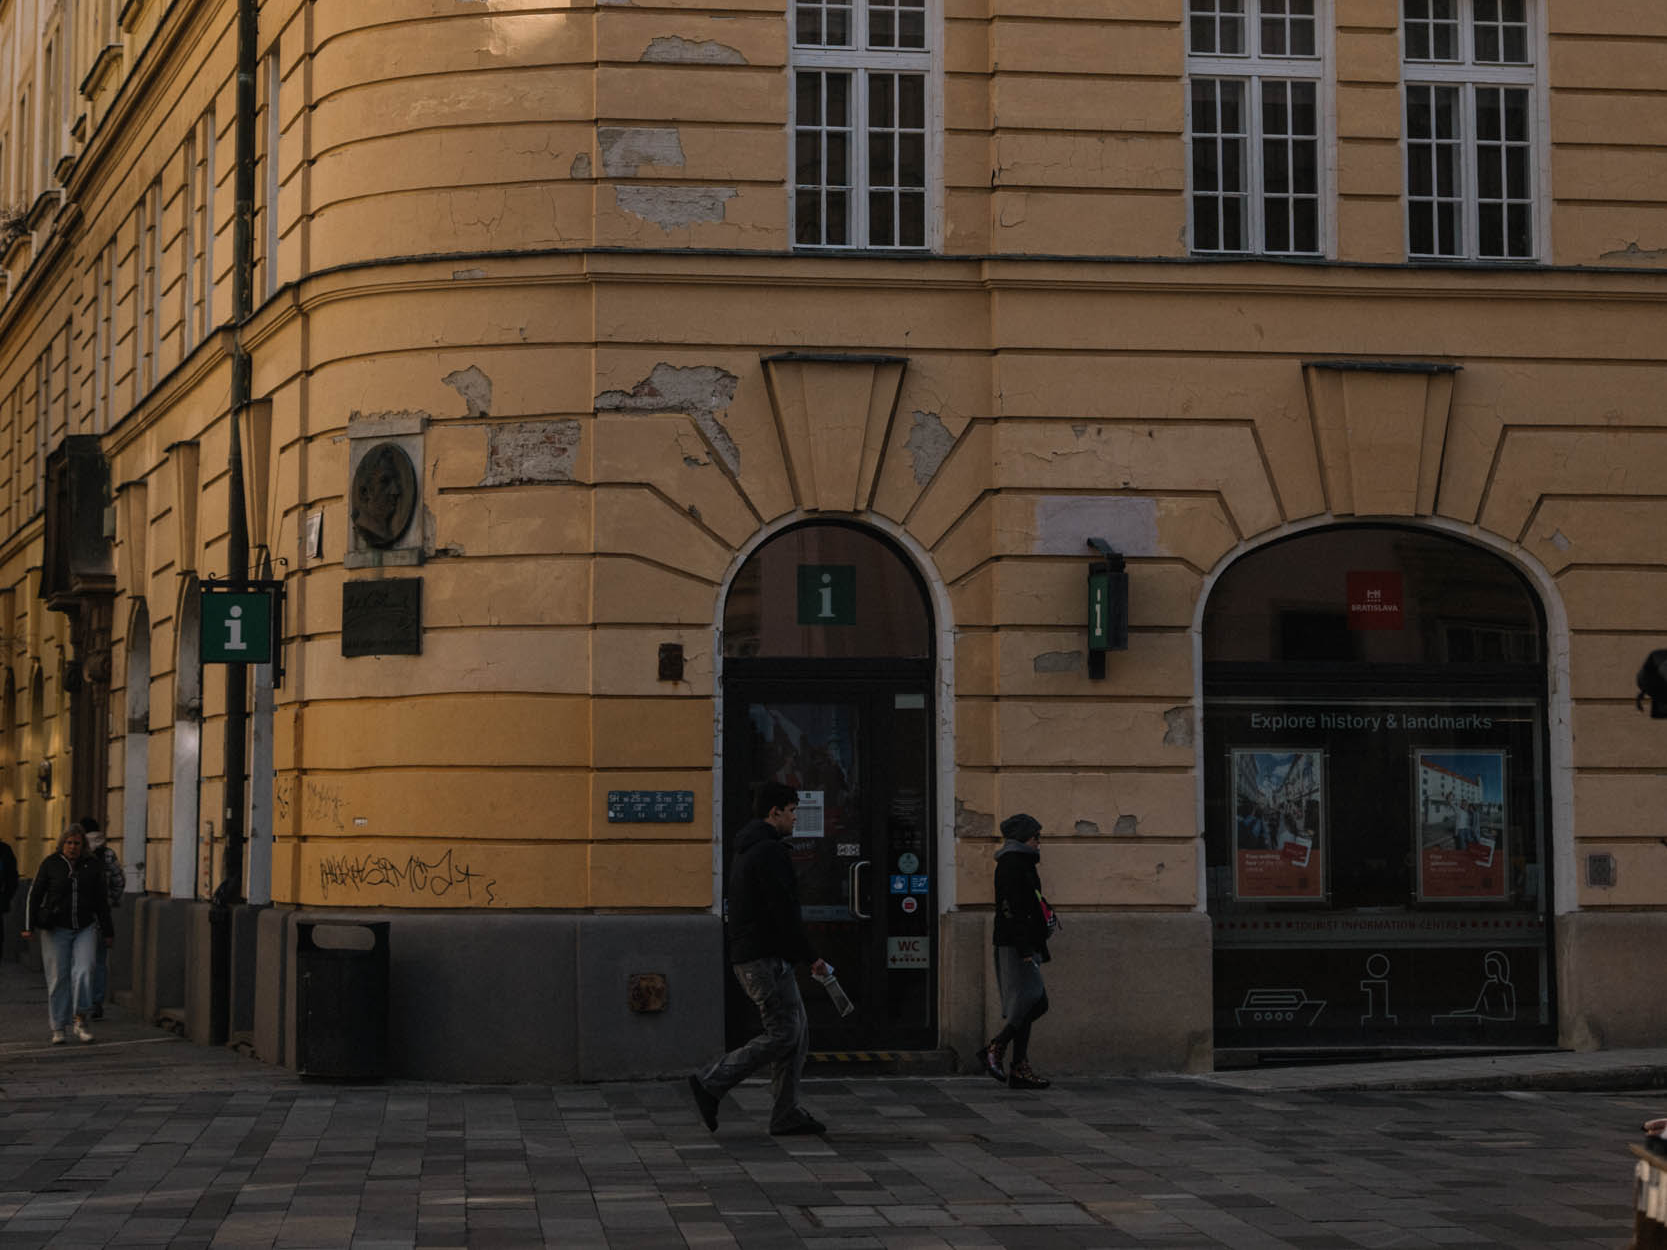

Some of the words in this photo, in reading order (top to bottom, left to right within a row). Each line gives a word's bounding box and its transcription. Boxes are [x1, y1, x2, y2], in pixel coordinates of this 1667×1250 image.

[1351, 604, 1399, 613] BRATISLAVA
[1250, 712, 1317, 732] Explore
[1320, 712, 1382, 732] history
[1385, 713, 1398, 729] &
[1402, 712, 1494, 729] landmarks
[1295, 919, 1337, 932] TOURIST
[1342, 919, 1416, 932] INFORMATION
[897, 940, 921, 952] WC
